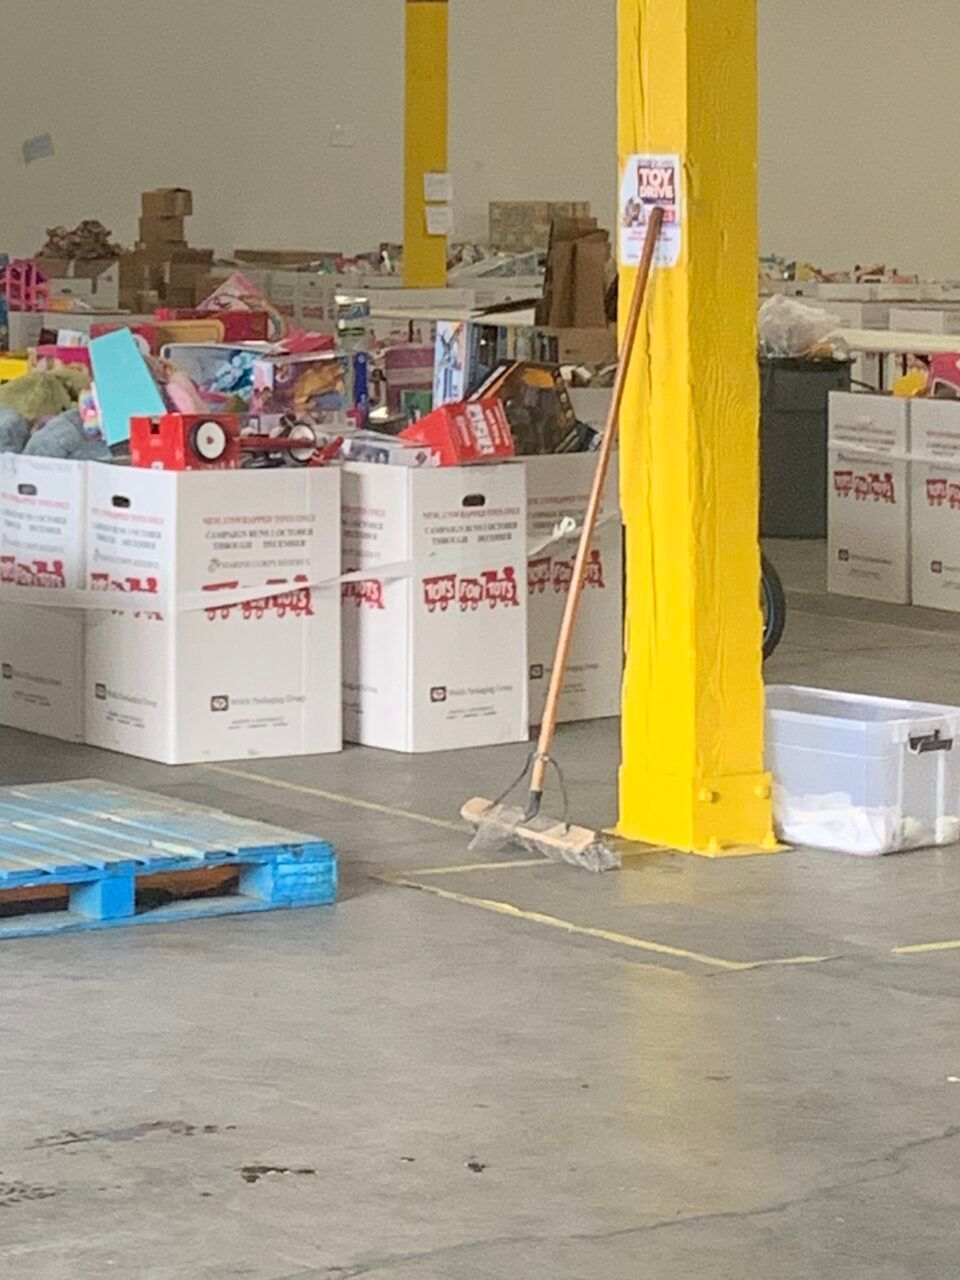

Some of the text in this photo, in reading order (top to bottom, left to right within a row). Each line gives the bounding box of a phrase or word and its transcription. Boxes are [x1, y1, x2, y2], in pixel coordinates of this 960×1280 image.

[639, 168, 672, 187] TOY
[425, 580, 514, 600] TOYS FOR TOTS
